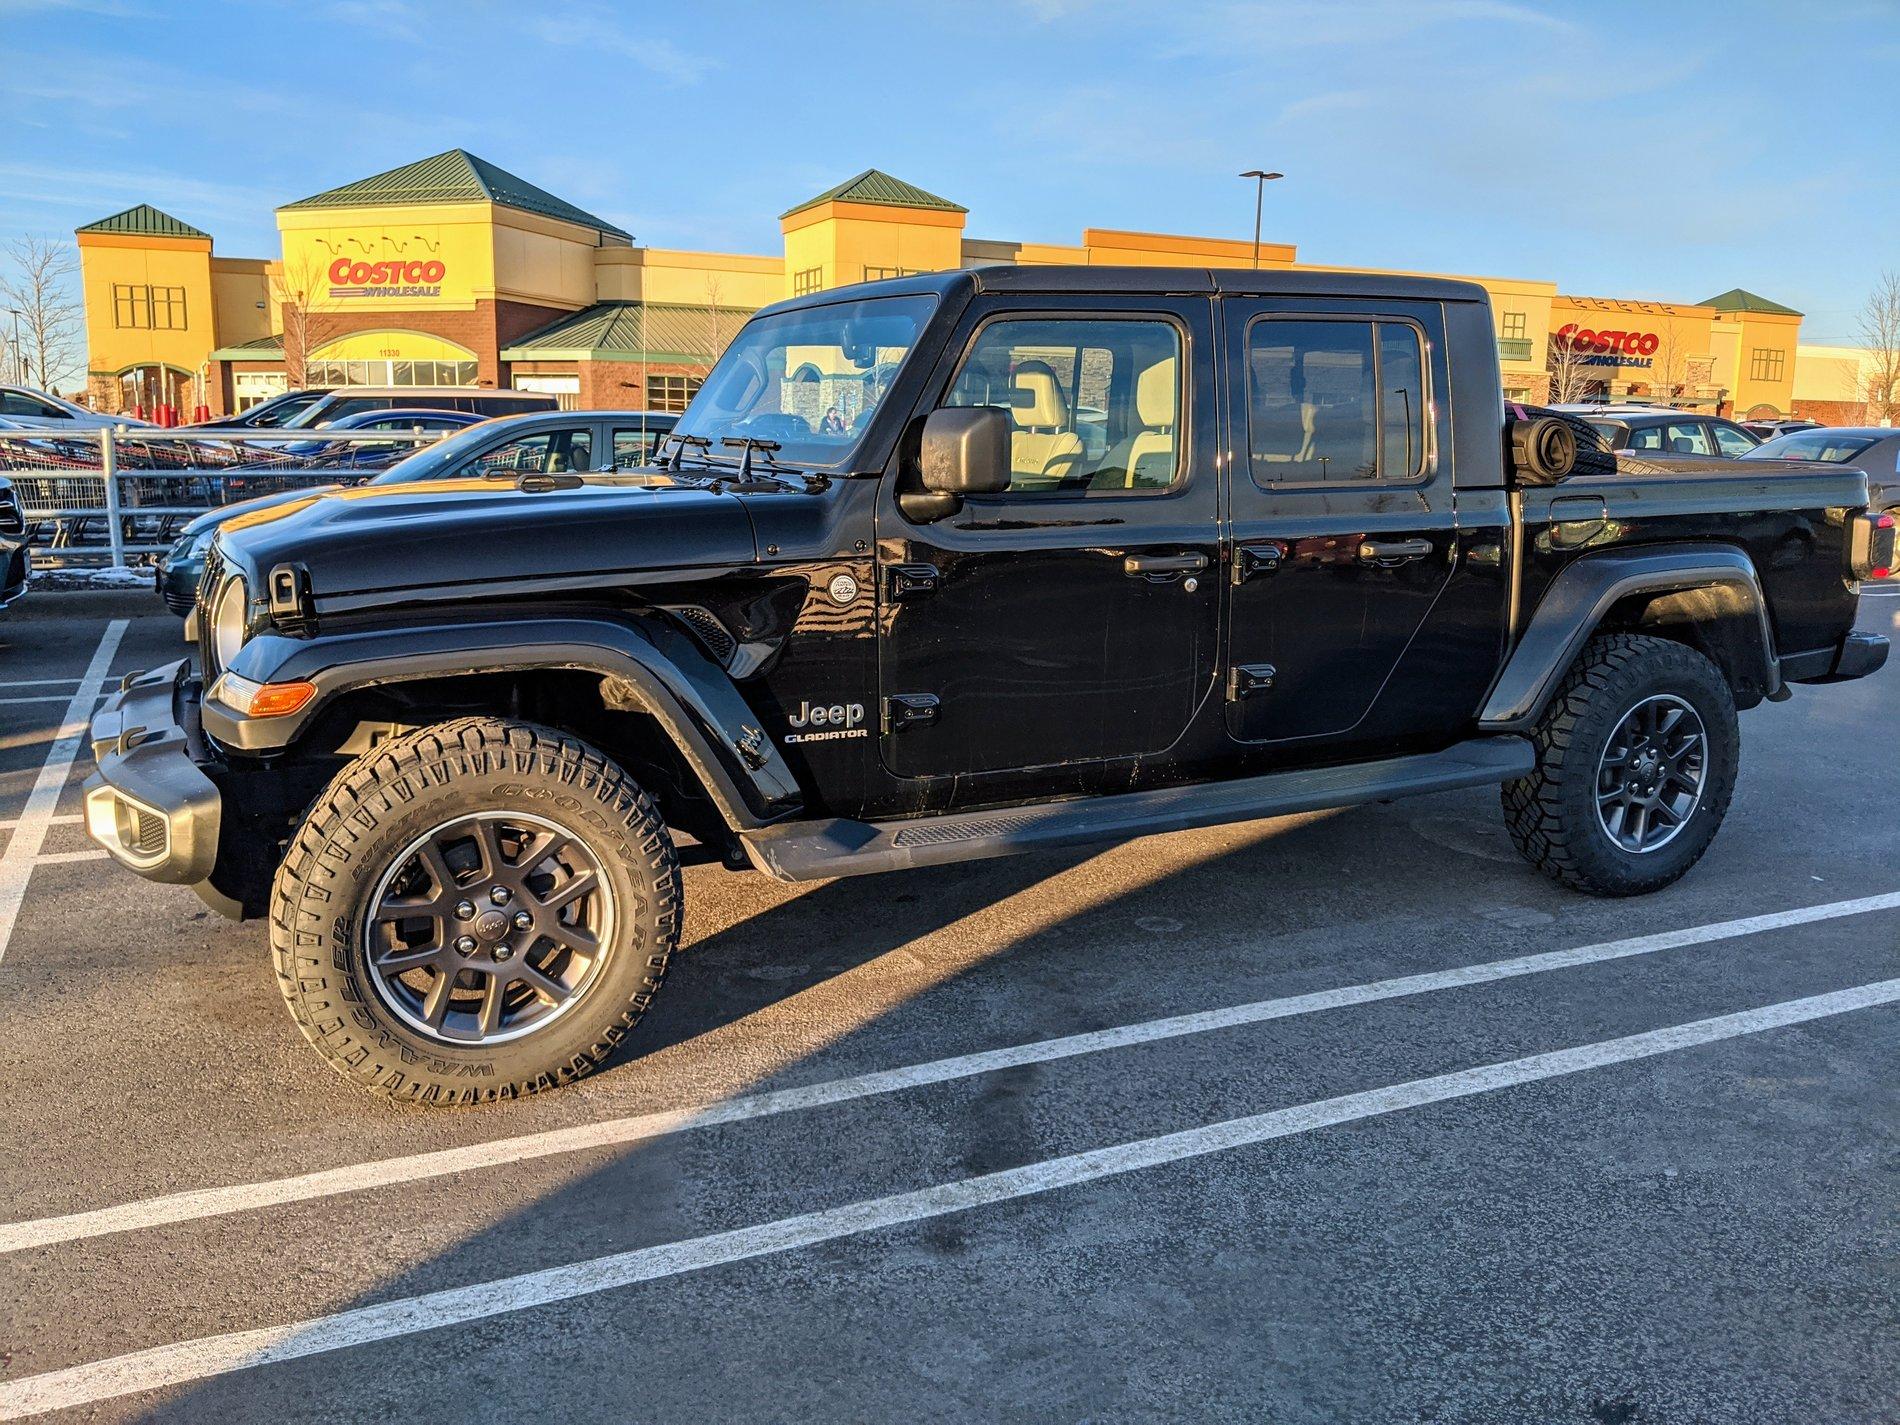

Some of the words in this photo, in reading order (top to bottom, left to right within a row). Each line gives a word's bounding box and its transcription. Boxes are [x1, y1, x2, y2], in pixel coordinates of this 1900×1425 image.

[328, 257, 446, 285] COSTCO
[363, 286, 441, 297] WHOLESALE
[1557, 323, 1659, 354] COSTCO
[379, 349, 400, 358] 11330
[1588, 355, 1653, 368] WHOLESALE
[789, 701, 865, 729] Jeep
[784, 729, 868, 744] GLADIATOR
[491, 783, 649, 952] GOODYEAR
[331, 916, 496, 1078] WRANGLER
